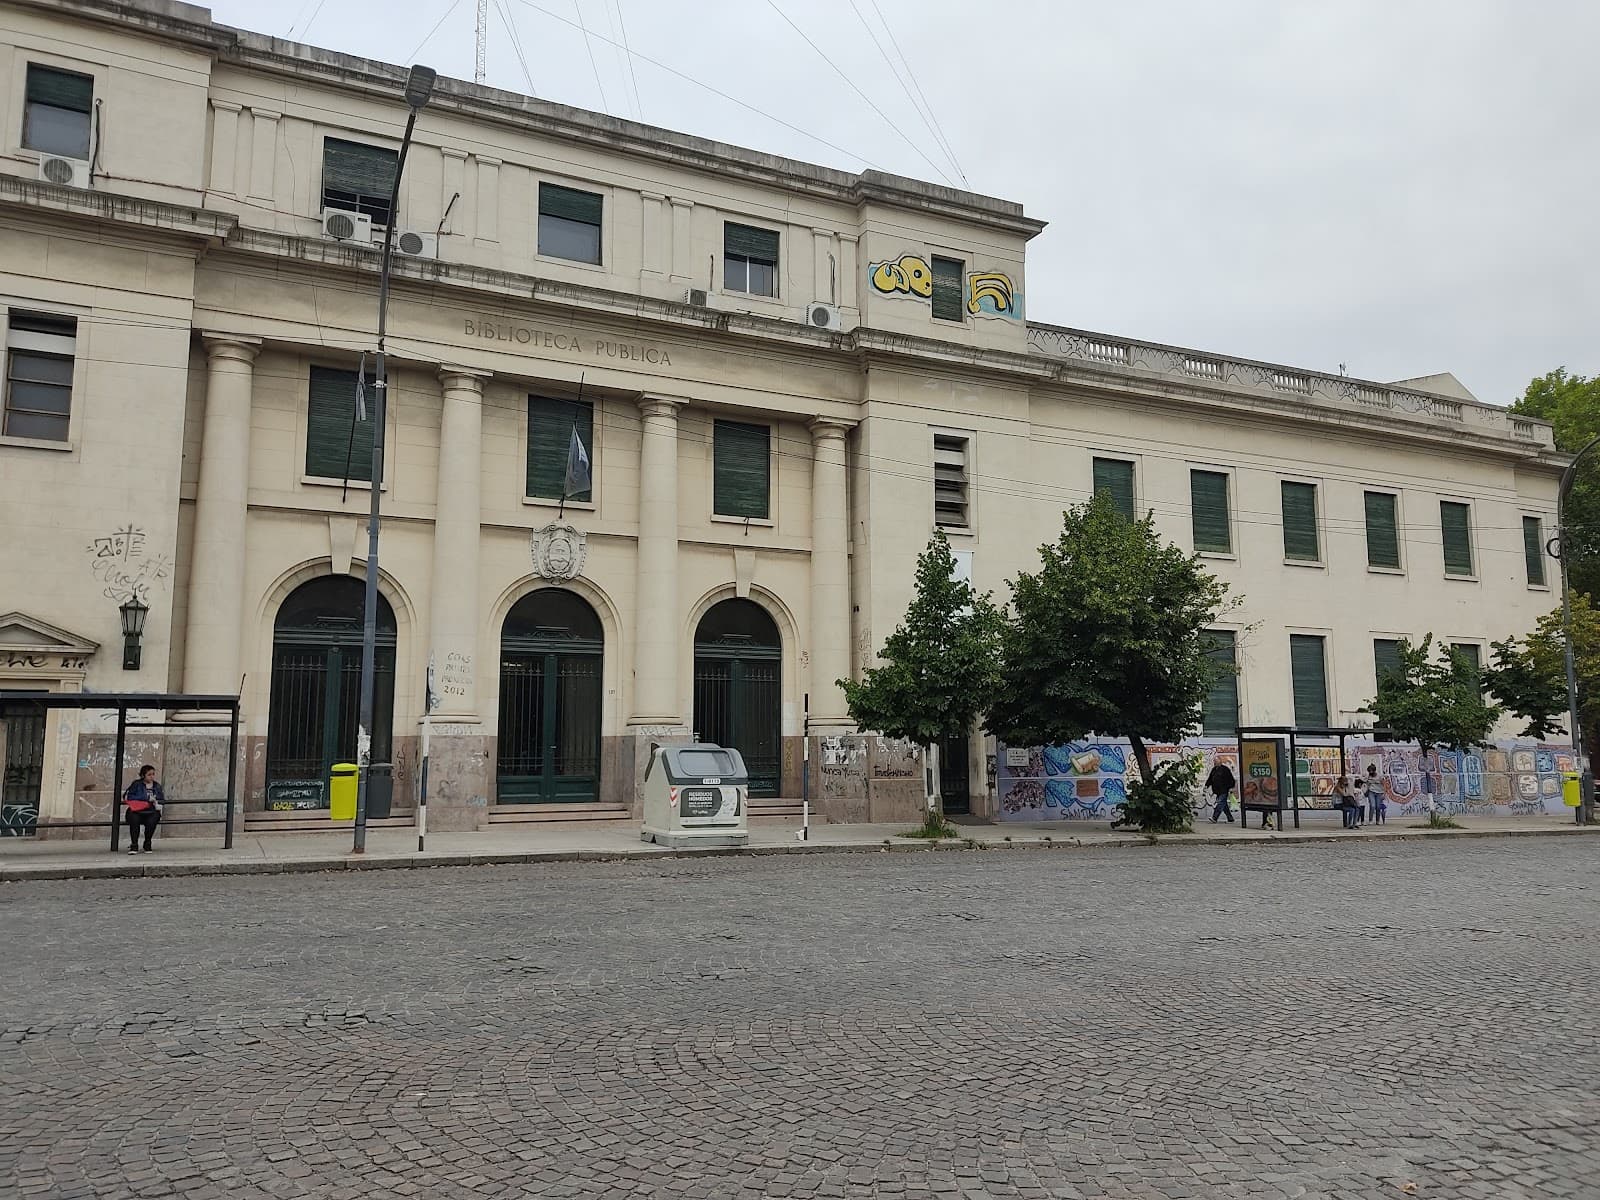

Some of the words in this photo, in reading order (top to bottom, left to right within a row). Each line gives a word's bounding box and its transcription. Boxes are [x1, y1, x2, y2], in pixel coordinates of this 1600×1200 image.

[464, 319, 582, 352] BIBLIOTECA
[596, 340, 672, 366] PUBLICA
[443, 685, 465, 696] 2012
[1253, 767, 1271, 776] $150
